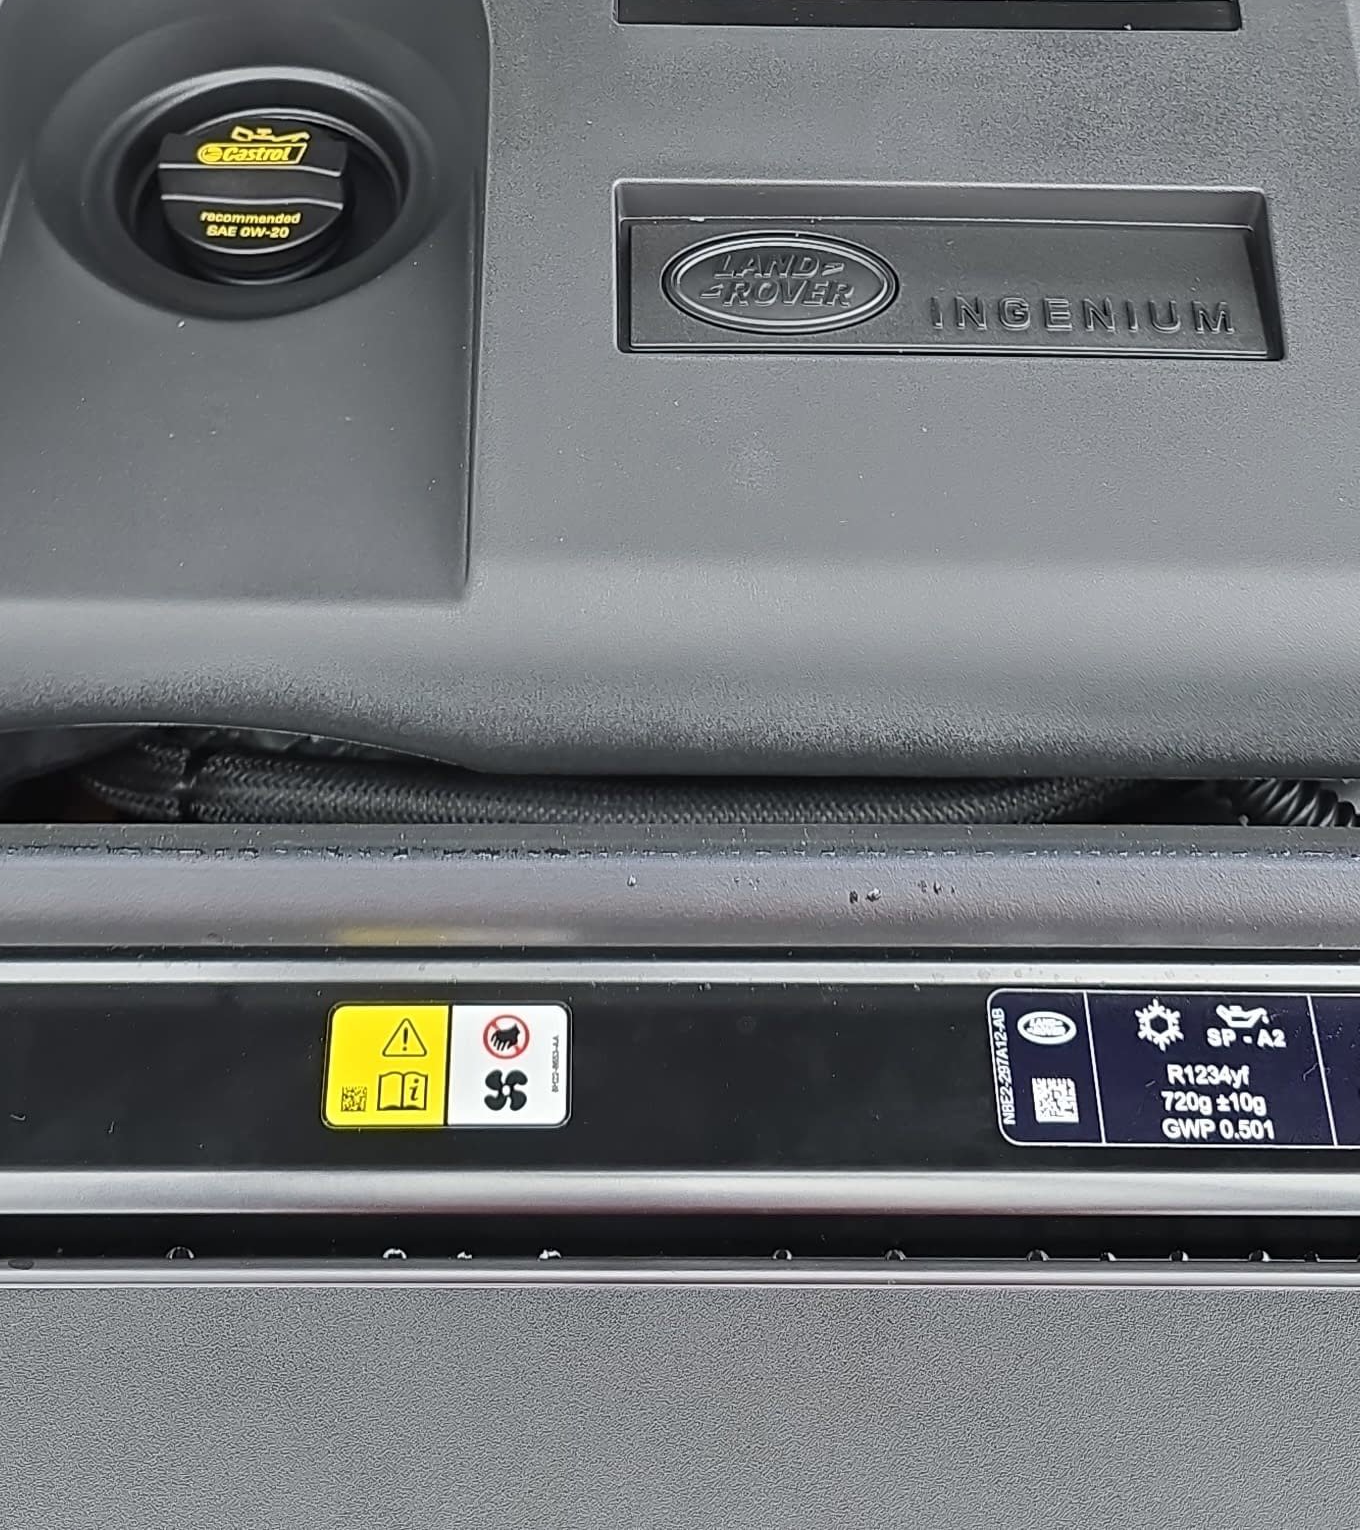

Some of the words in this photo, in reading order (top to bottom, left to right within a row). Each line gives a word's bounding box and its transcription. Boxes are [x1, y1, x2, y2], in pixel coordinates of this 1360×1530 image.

[223, 147, 292, 161] Castrol
[200, 211, 301, 224] recommended
[205, 225, 238, 237] SAE
[240, 226, 290, 238] 0W-20
[714, 254, 820, 279] LAND
[723, 280, 855, 308] ROVER
[931, 295, 1236, 335] INGENIUM
[1206, 1028, 1237, 1047] SP
[1257, 1028, 1287, 1048] A2
[1167, 1064, 1250, 1089] R1234yf
[1161, 1091, 1213, 1116] 720g
[1216, 1091, 1268, 1117] ±10g
[1162, 1118, 1216, 1140] GWP
[1219, 1118, 1276, 1140] 0.501
